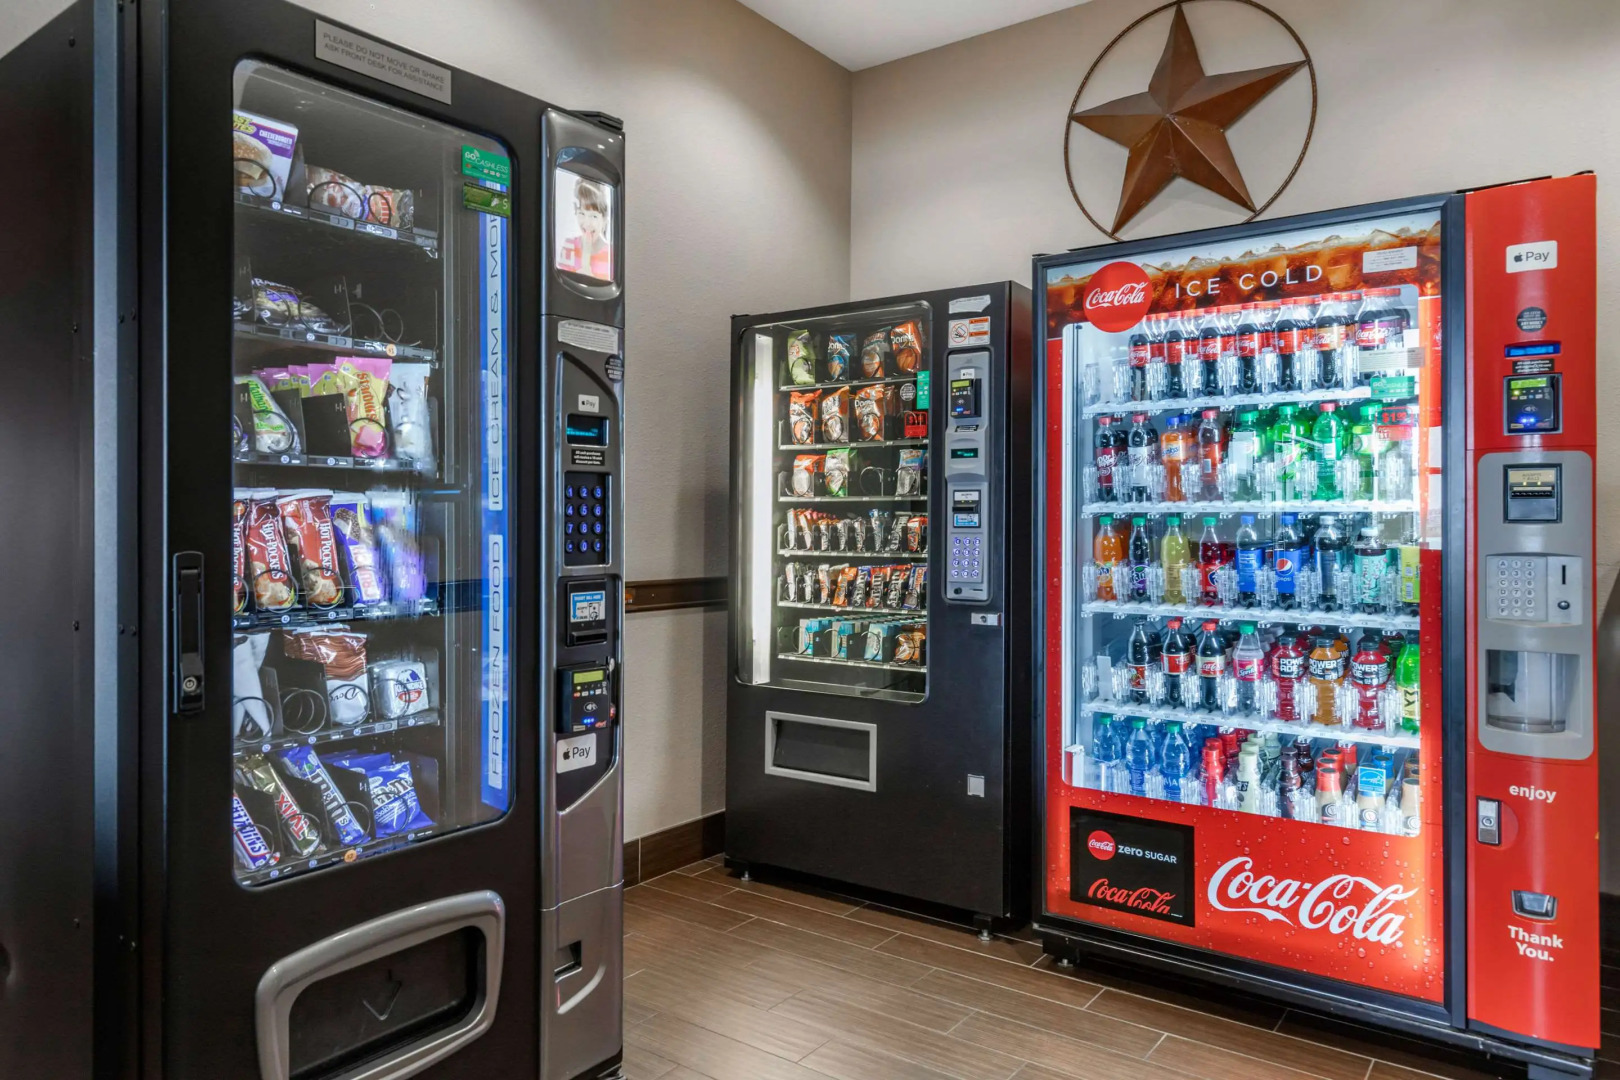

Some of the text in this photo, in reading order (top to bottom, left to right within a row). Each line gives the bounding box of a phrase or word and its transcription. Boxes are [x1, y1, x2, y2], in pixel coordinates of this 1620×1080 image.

[323, 32, 445, 84] PLEASE DO NOT MOVE OR SHAKE
[324, 42, 444, 92] ASK FRONT DESK FOR ASSISTANCE
[475, 157, 509, 174] CASHLESS
[1525, 251, 1550, 262] Pay
[1085, 281, 1149, 310] Coca-Cola
[1175, 265, 1323, 299] ICE COLD
[490, 289, 499, 315] &
[490, 327, 500, 445] CREAM
[585, 400, 596, 408] Pay
[491, 457, 501, 506] ICE
[262, 523, 283, 580] HOT POCKETS
[320, 522, 333, 577] HOT POCKETS
[491, 540, 501, 776] FROZEN FOOD
[572, 746, 591, 759] Pay
[1509, 785, 1557, 803] enjoy
[1088, 839, 1177, 864] Coca-Cola zero SUGAR
[1207, 856, 1420, 946] Coca-Cola
[1507, 924, 1564, 949] Thank
[1516, 941, 1555, 962] You.
